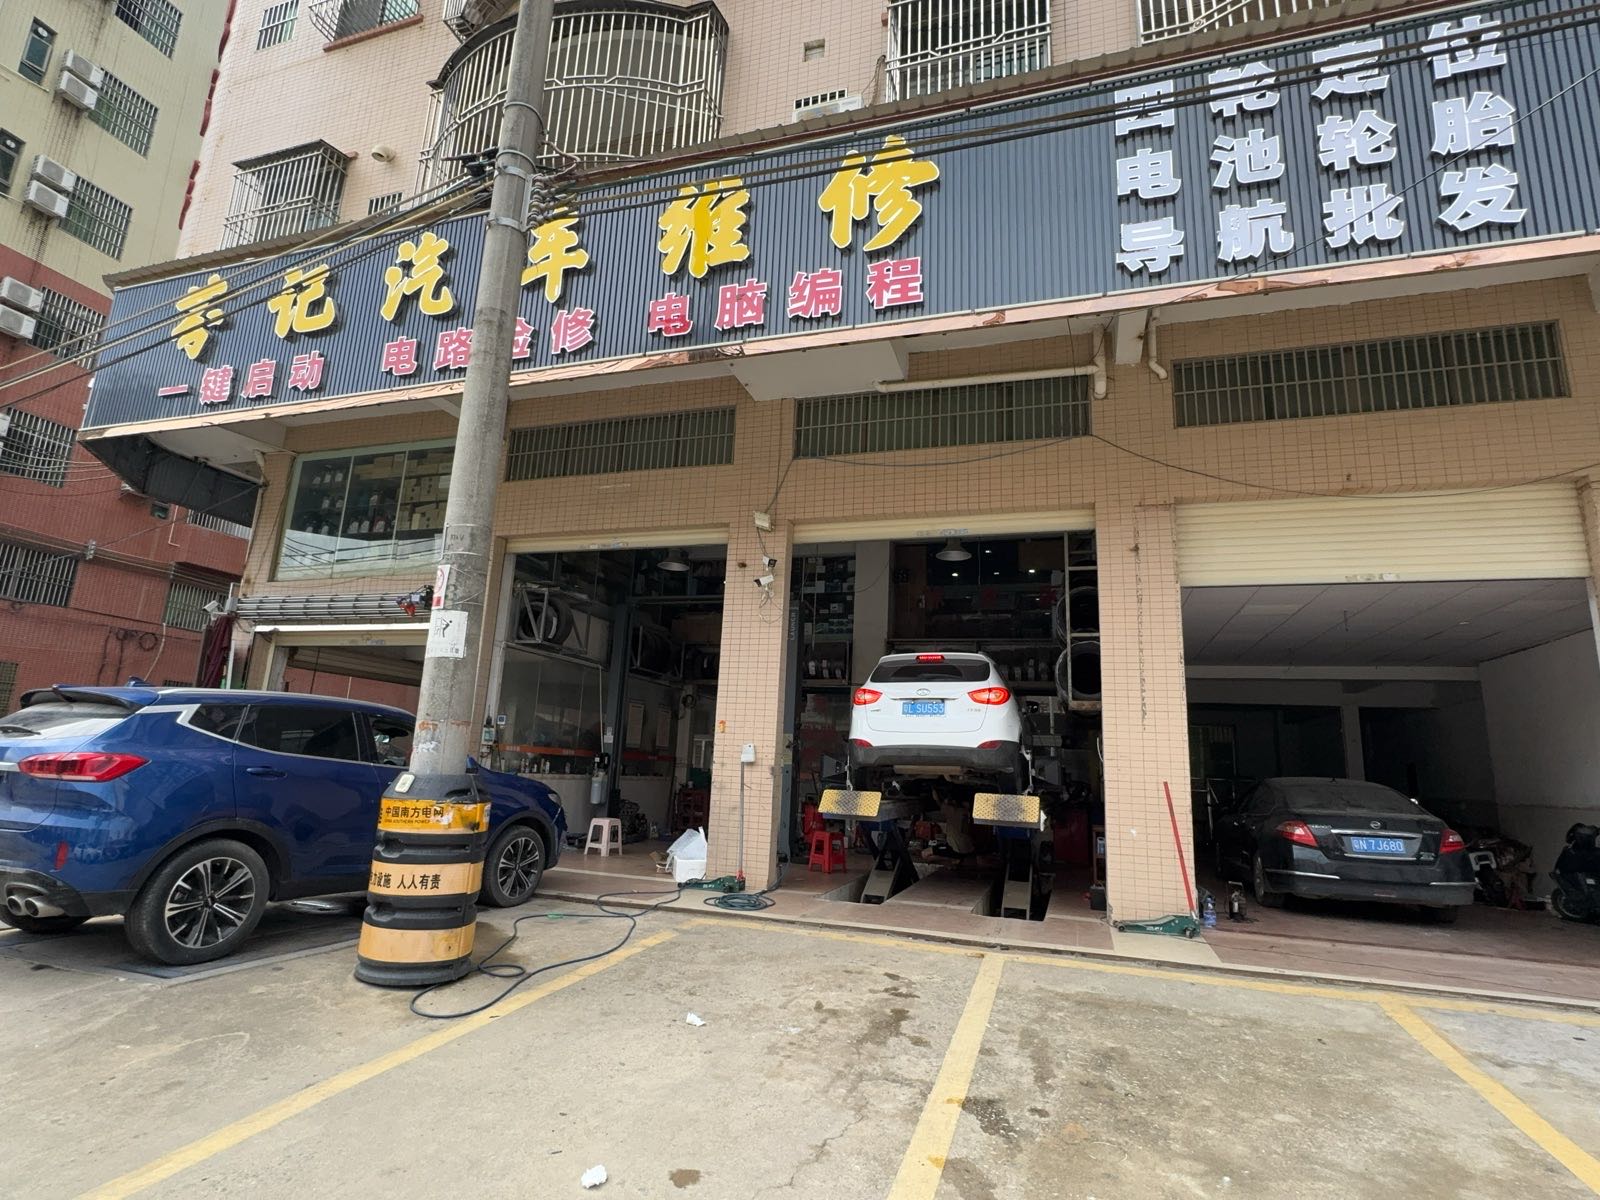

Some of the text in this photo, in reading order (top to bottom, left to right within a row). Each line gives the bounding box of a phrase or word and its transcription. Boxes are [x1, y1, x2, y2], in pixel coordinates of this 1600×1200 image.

[1114, 15, 1507, 136] 四轮定位
[1116, 91, 1516, 199] 电池轮胎
[1115, 163, 1528, 274] 导航批发
[158, 350, 325, 405] 一键启动
[648, 256, 924, 338] 电脑编程
[916, 703, 944, 714] SU553
[385, 806, 445, 818] 中国南方电网
[1368, 839, 1404, 852] 7J680
[397, 874, 441, 890] 人人有责
